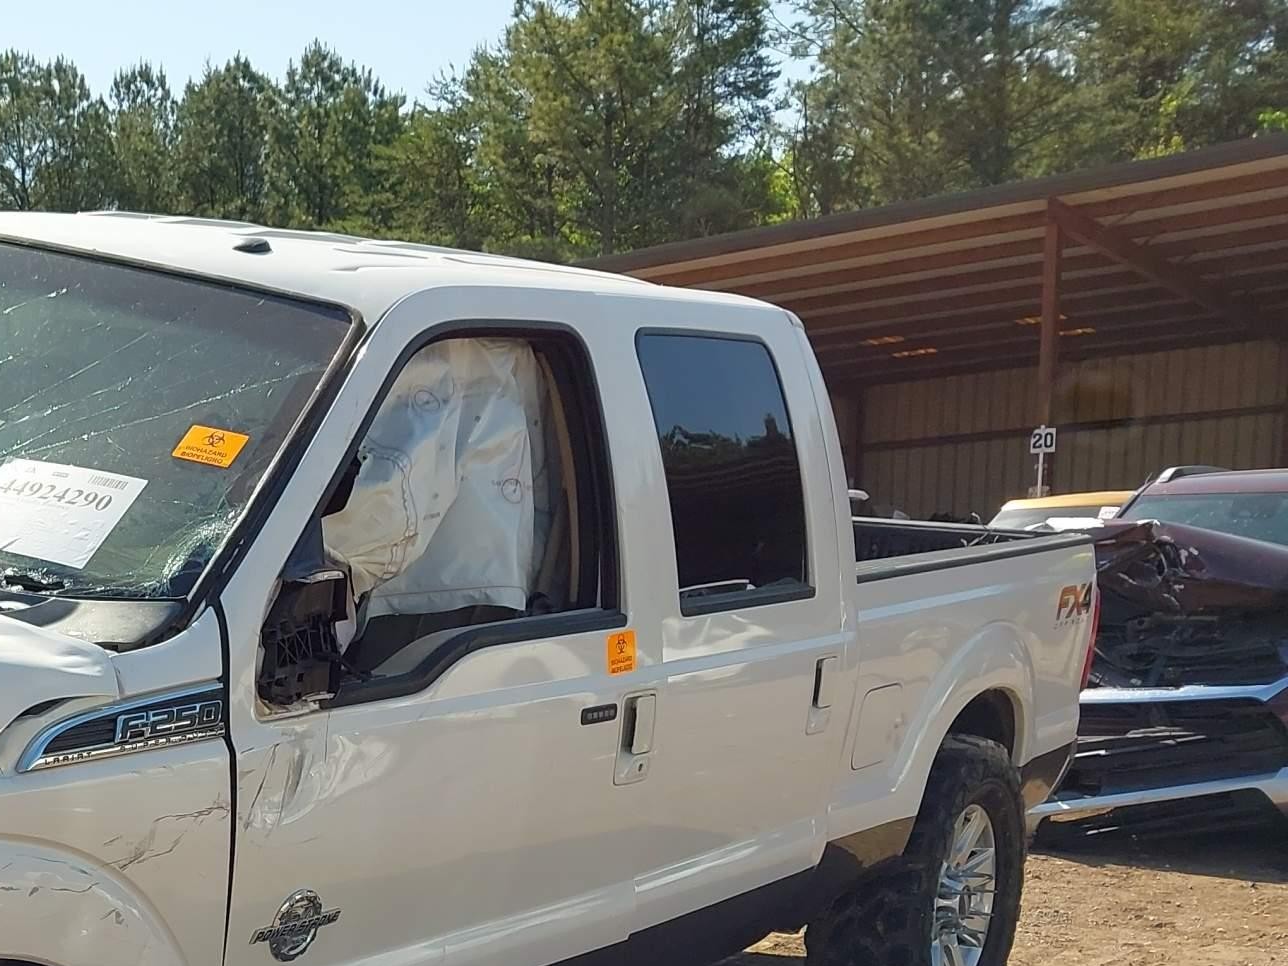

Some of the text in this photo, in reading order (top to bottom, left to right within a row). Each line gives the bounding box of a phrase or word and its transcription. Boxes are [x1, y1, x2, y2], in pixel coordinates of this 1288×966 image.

[1032, 432, 1054, 449] 20
[0, 479, 112, 512] 44924290
[1055, 582, 1093, 621] FX4
[44, 751, 92, 765] LARIAT
